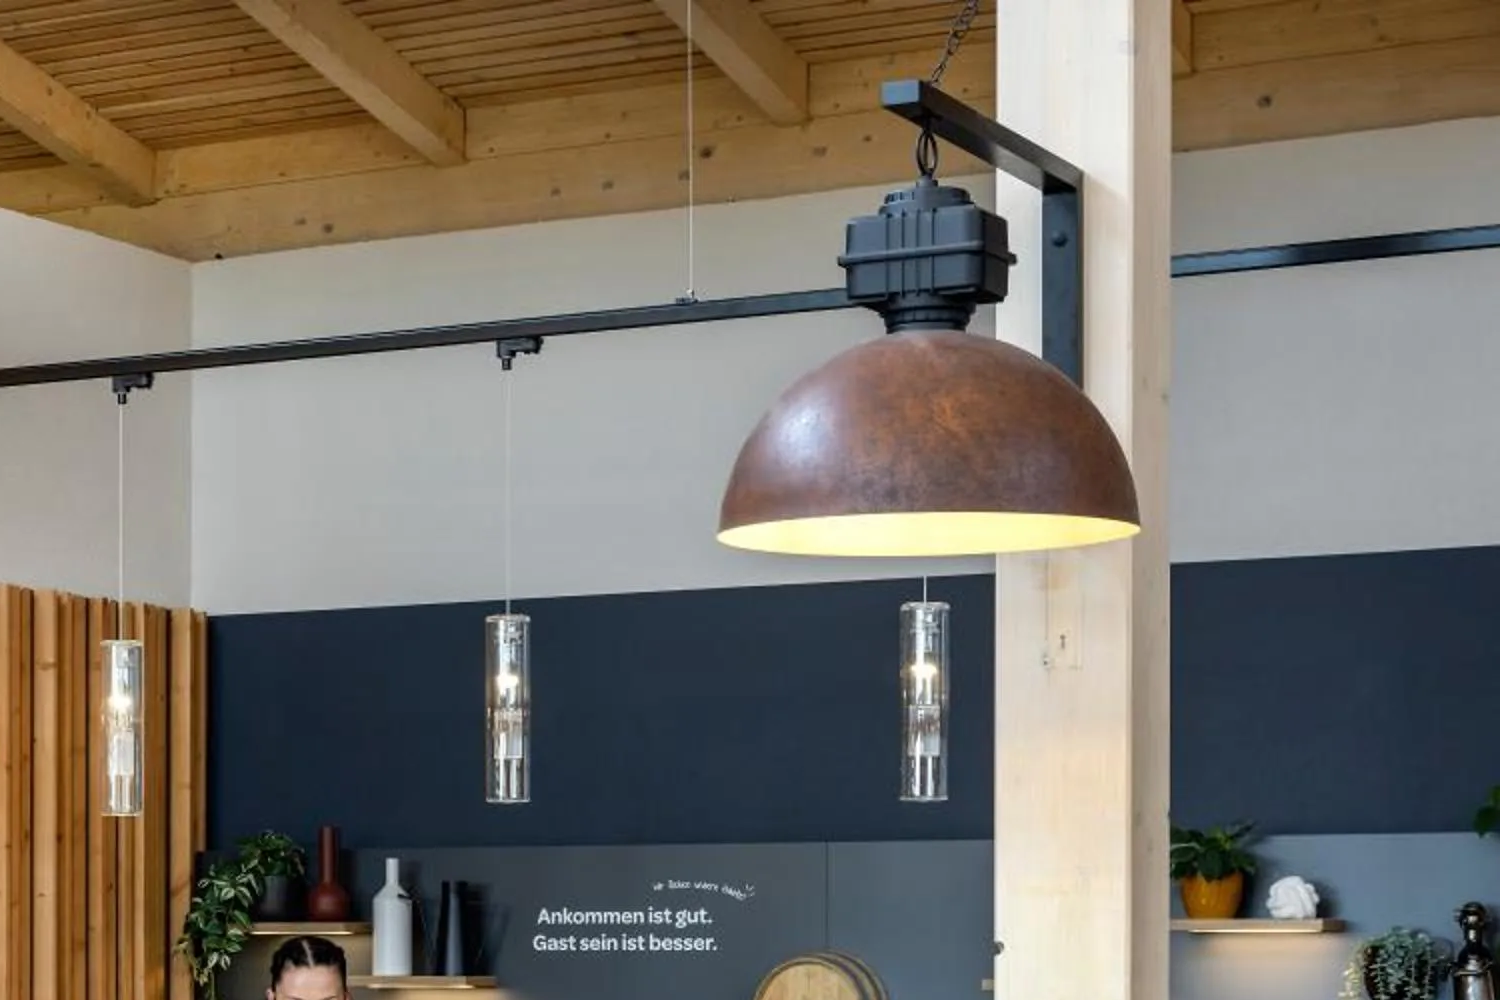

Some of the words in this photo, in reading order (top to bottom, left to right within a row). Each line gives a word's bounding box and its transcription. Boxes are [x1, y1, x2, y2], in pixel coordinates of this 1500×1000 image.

[537, 907, 645, 924] Ankommen
[648, 906, 672, 924] ist
[675, 907, 713, 929] gut.
[532, 934, 577, 951] Gast
[579, 933, 618, 951] sein
[621, 933, 645, 951] ist
[649, 932, 718, 951] besser.
